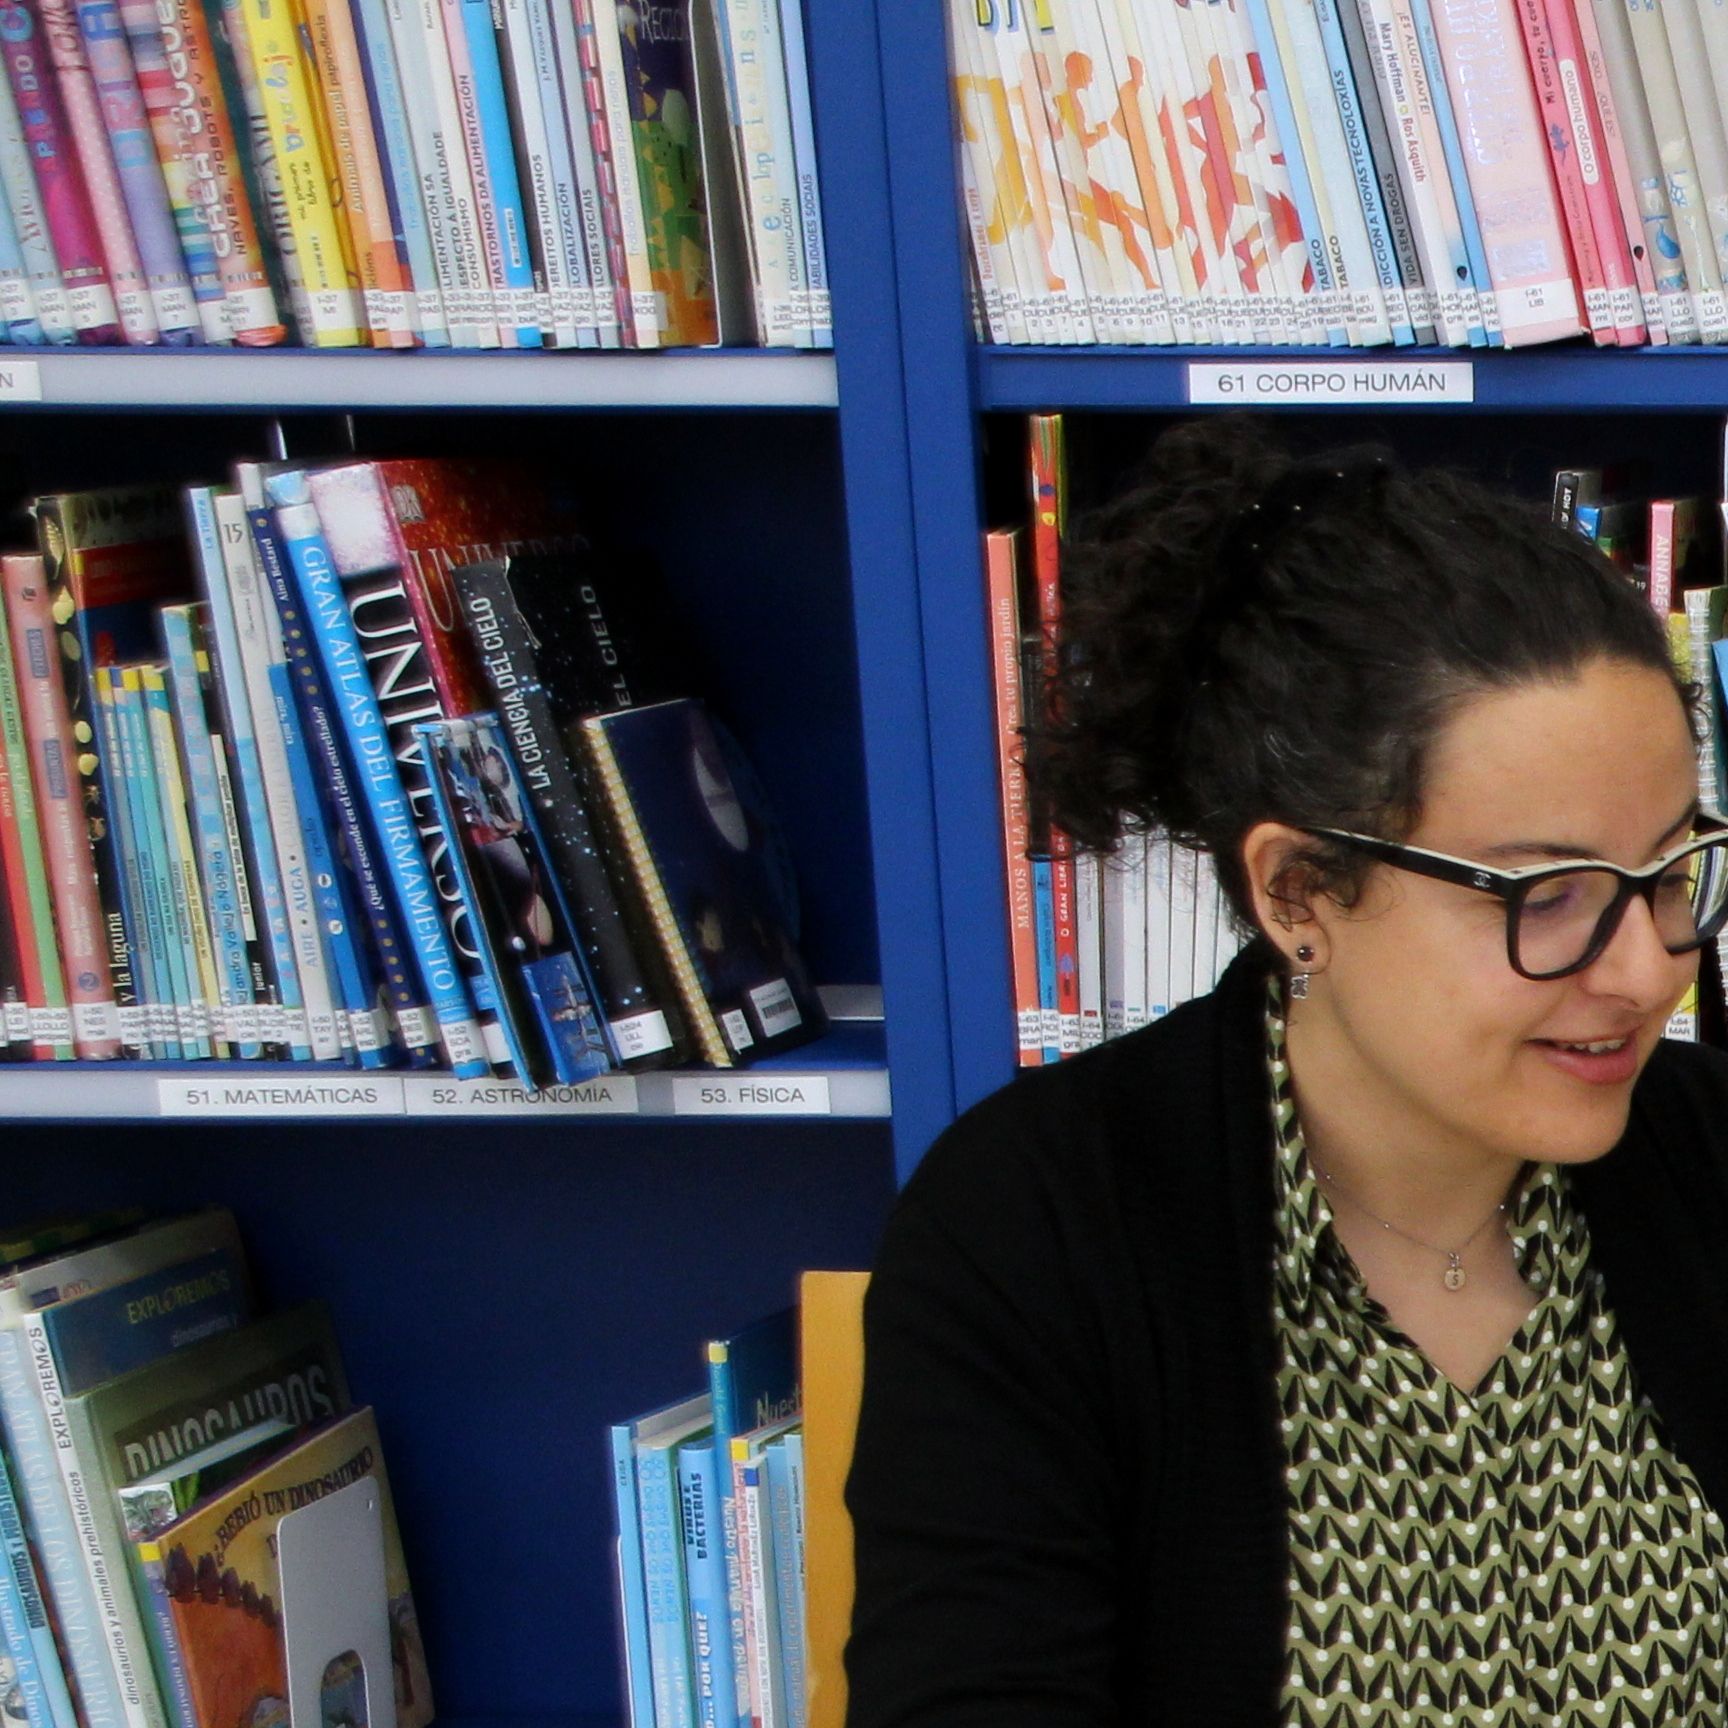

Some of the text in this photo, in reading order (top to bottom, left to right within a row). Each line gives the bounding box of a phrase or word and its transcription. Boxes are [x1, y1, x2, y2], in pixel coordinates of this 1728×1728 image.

[1217, 368, 1446, 393] 61 CORPO HUMÁN
[468, 596, 553, 792] LA CIENCIA DEL CIELO
[301, 545, 457, 992] GRAN ATLAS DEL FIRMAMENTO
[186, 1083, 378, 1107] 51. MATEMÁTICAS
[432, 1087, 464, 1106] 52.
[700, 1082, 806, 1106] 53. FÍSICA
